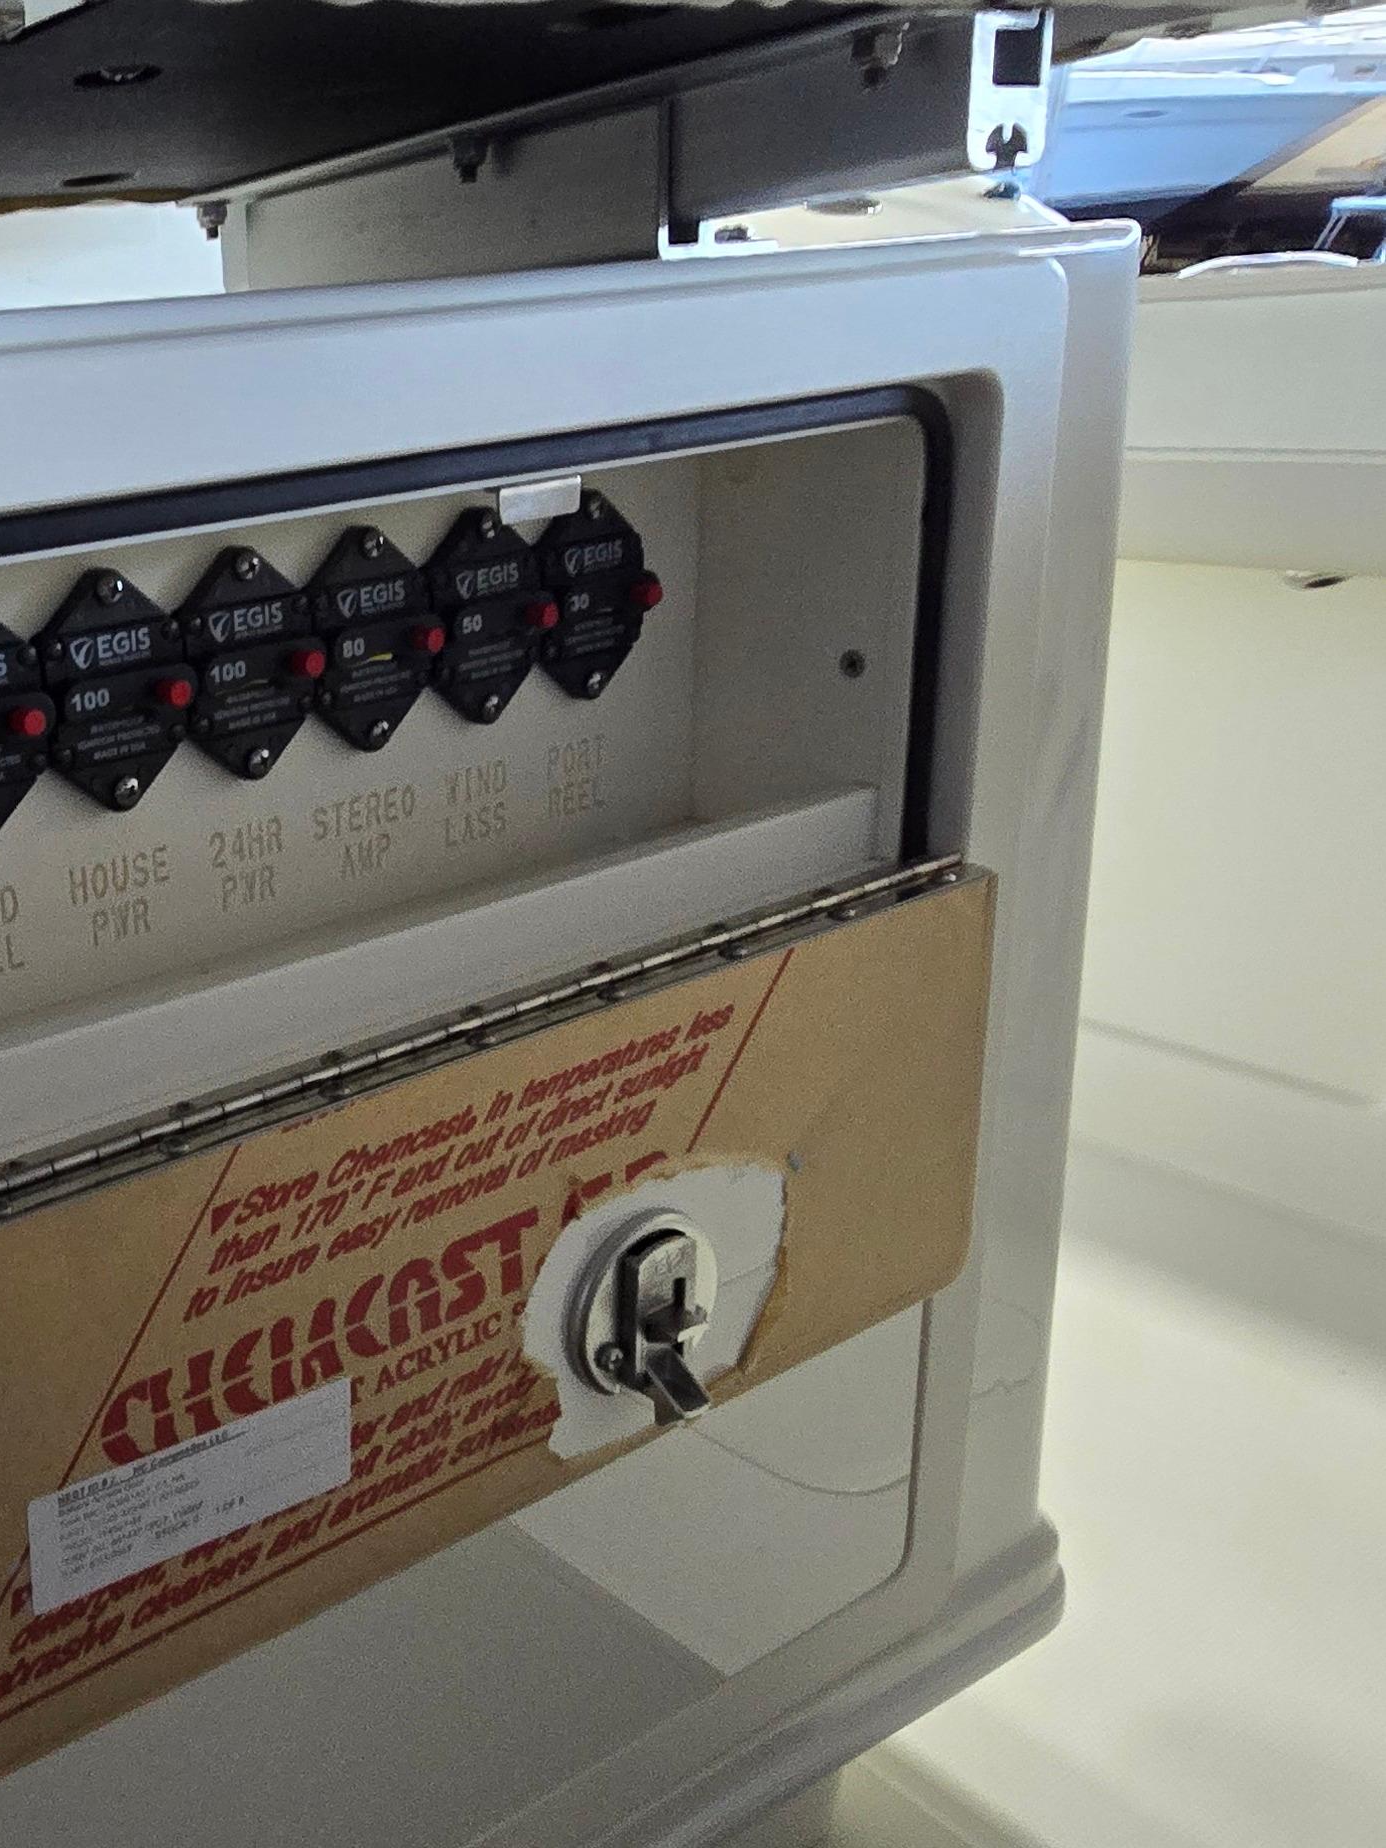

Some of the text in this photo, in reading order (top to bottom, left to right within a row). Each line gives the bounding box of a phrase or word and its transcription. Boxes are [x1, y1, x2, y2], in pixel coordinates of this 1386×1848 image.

[477, 563, 519, 591] EGIS
[583, 540, 623, 566] EGIS
[233, 602, 283, 632] EGIS
[360, 580, 405, 609] EGIS
[97, 627, 150, 658] EGIS
[210, 661, 246, 683] 100
[71, 688, 110, 712] 100
[313, 784, 414, 841] STEREO
[445, 801, 507, 848] LASS
[209, 816, 283, 868] 24HR
[69, 847, 169, 904] HOUSE
[235, 1170, 319, 1226] Store
[483, 1090, 513, 1124] in
[517, 1025, 681, 1111] temperatures
[684, 1003, 735, 1043] less
[208, 1222, 280, 1275] than
[391, 1145, 455, 1198] and
[454, 1126, 504, 1172] out
[504, 1109, 541, 1151] of
[538, 1080, 614, 1136] direct
[614, 1042, 710, 1105] sunlight
[183, 1286, 219, 1323] to
[224, 1243, 320, 1305] insure
[327, 1207, 402, 1261] easy
[401, 1152, 518, 1229] removal
[516, 1138, 554, 1180] of
[549, 1100, 657, 1166] masking
[374, 1311, 502, 1395] ACRYLIC
[265, 1498, 333, 1560] and
